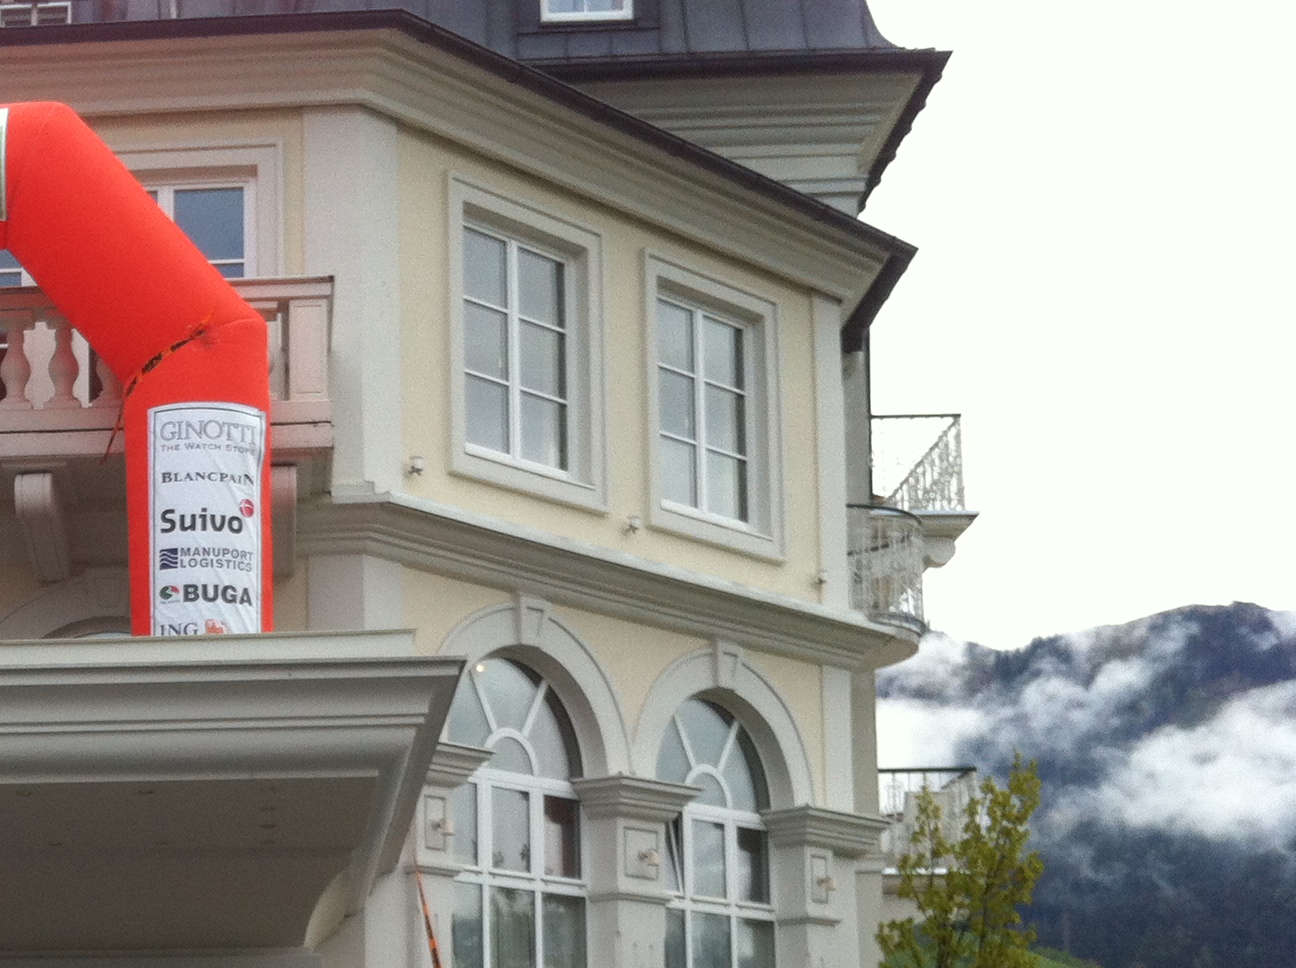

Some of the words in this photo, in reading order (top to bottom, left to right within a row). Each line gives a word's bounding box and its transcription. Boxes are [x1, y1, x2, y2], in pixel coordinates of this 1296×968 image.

[160, 419, 257, 445] GINOTTI
[160, 443, 181, 453] THE
[184, 442, 222, 451] WATCH
[160, 471, 255, 487] BLANCPAIN
[160, 507, 243, 534] Suivo
[179, 547, 253, 561] MANUPORT
[179, 558, 252, 572] LOGISTICS
[182, 583, 253, 607] BUGA
[160, 621, 199, 636] ING
